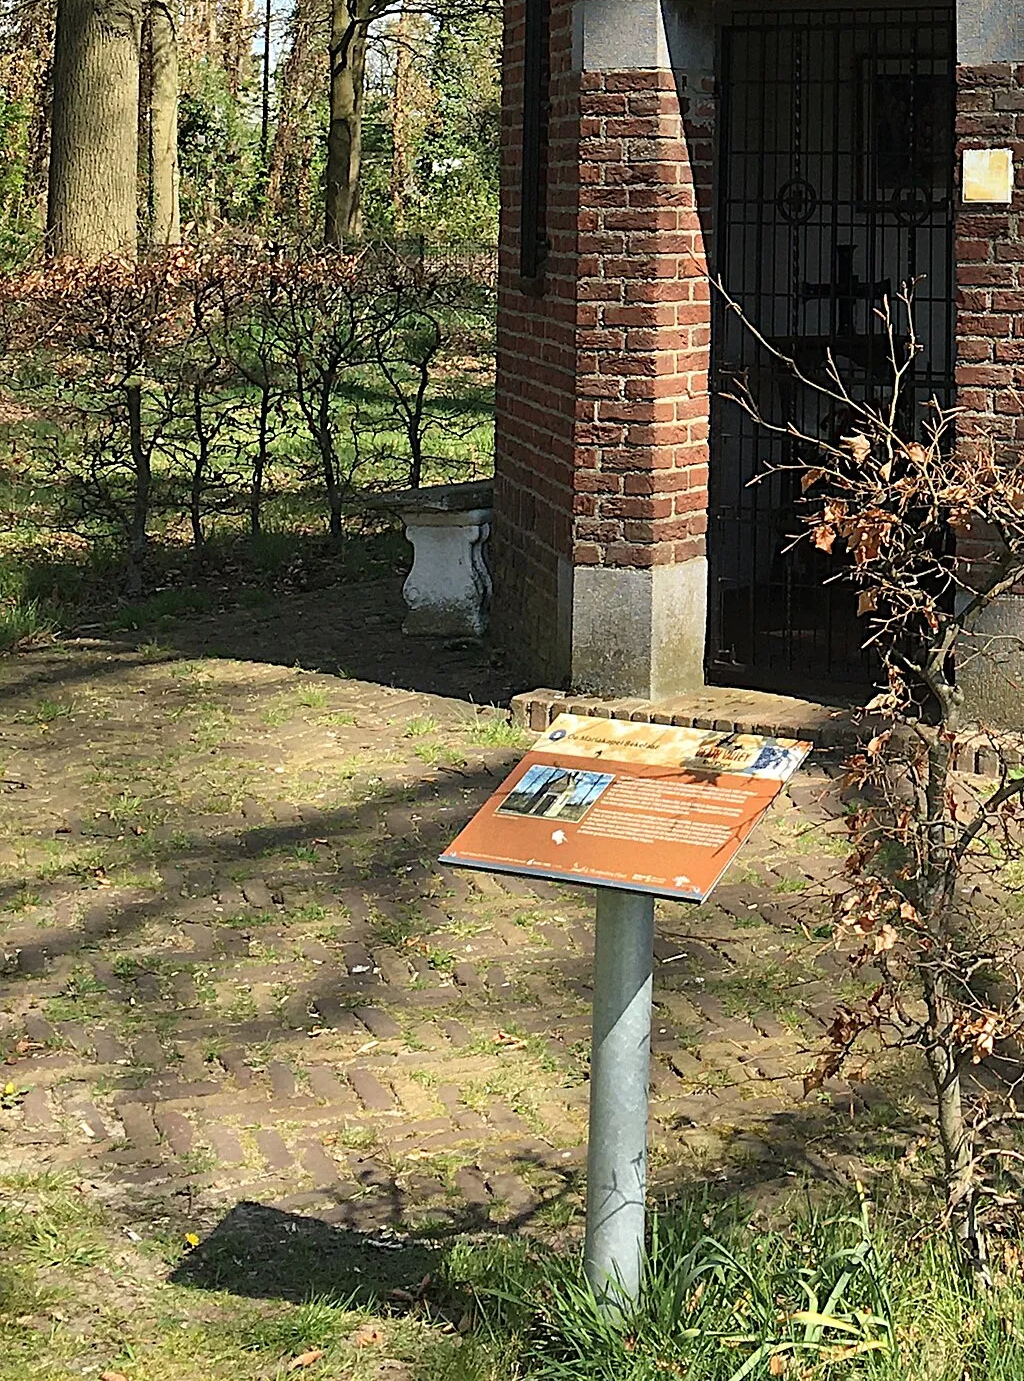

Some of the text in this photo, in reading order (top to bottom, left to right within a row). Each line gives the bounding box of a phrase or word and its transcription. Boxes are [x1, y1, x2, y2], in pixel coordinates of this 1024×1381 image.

[567, 733, 579, 741] De
[580, 735, 624, 746] Mariakapel
[695, 746, 752, 762] DEATH VALLEY
